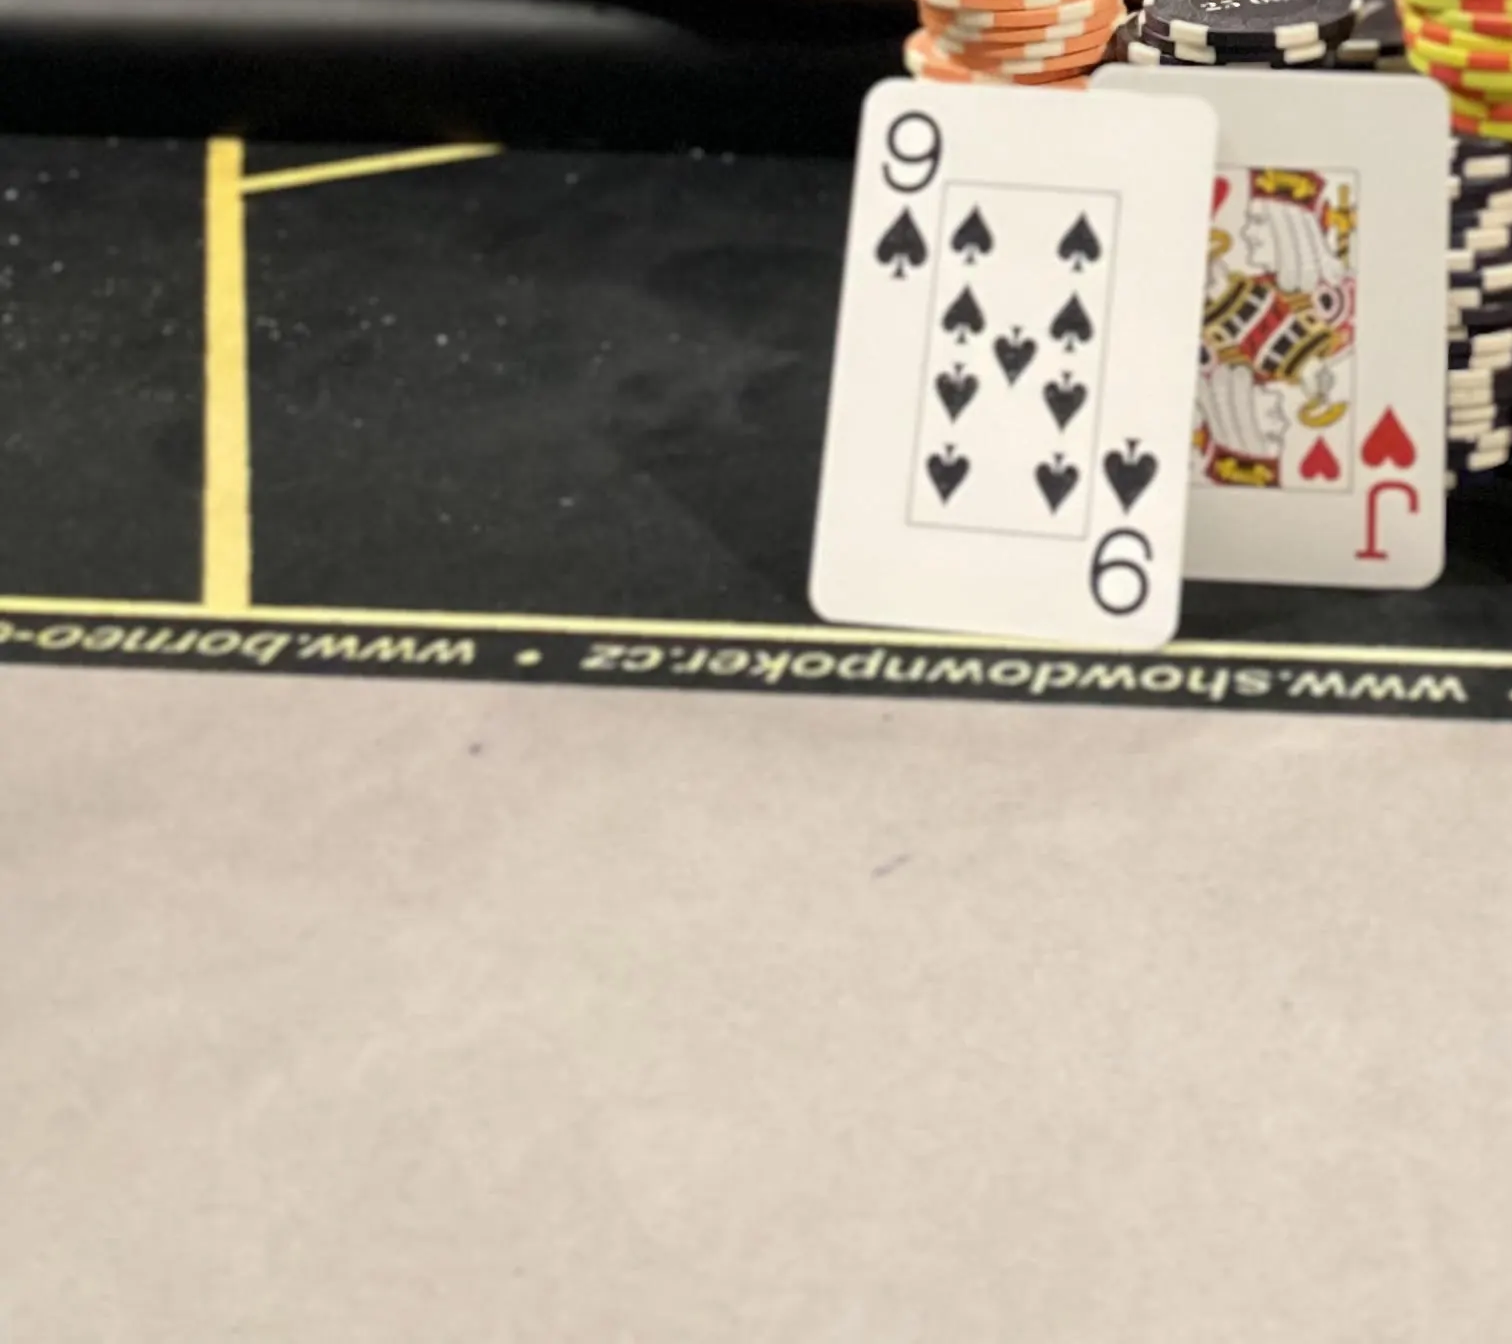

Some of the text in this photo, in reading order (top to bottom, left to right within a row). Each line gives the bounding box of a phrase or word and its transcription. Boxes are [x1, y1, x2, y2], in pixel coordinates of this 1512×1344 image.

[881, 110, 943, 193] 9
[1355, 481, 1419, 560] J
[1088, 527, 1154, 616] 9
[579, 643, 1468, 702] www.showdownpoker.cz
